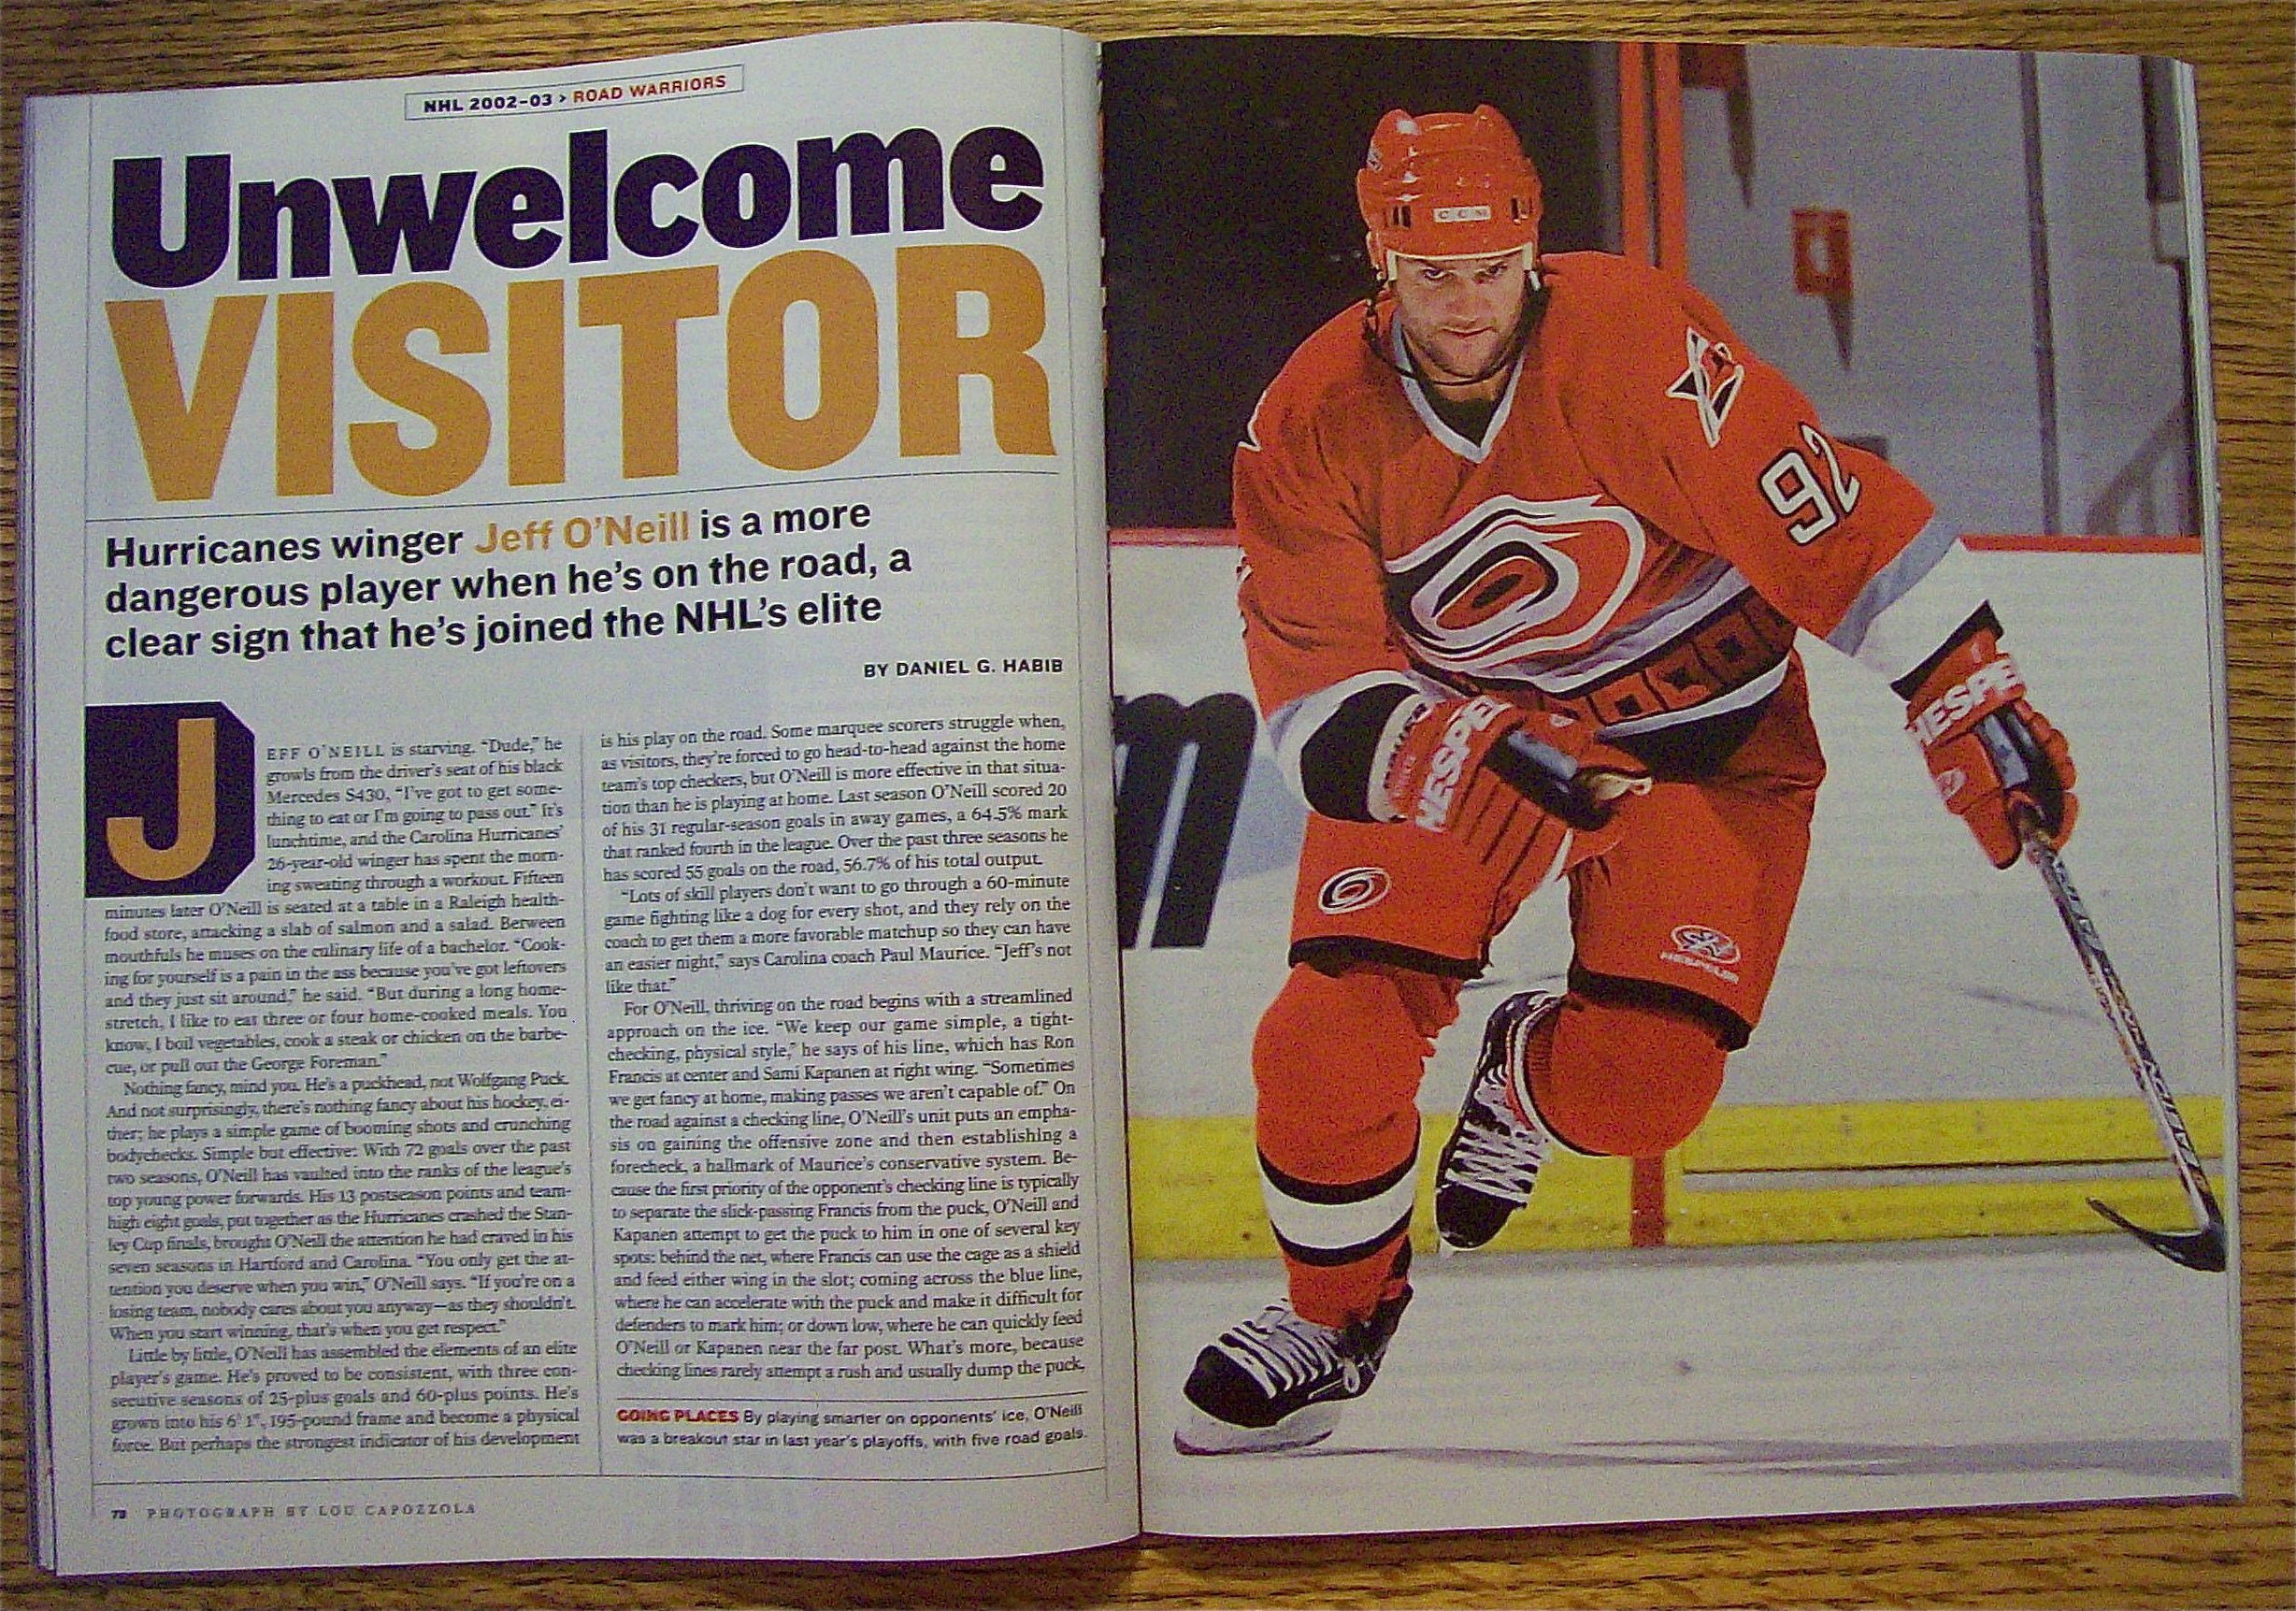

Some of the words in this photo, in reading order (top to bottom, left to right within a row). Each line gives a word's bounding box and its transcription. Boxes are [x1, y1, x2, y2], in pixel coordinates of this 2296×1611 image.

[423, 98, 464, 114] NHL
[469, 88, 552, 111] 2002-03
[572, 85, 624, 104] ROAD
[629, 74, 726, 97] WARRIORS
[111, 125, 1045, 288] Unwelcome
[105, 244, 1058, 502] VISITOR
[1758, 423, 1862, 546] 92
[106, 537, 321, 568] Hurricanes
[332, 529, 463, 564] winger
[477, 520, 552, 554] Jeff
[563, 511, 689, 549] O'Neill
[700, 509, 730, 539] is
[741, 511, 762, 538] a
[772, 504, 870, 534] more
[106, 583, 309, 617] dangerous
[320, 575, 440, 611] player
[452, 568, 556, 599] when
[567, 561, 642, 595] he's
[653, 563, 698, 589] on
[709, 553, 769, 585] the
[780, 544, 877, 580] road,
[889, 547, 911, 573] a
[106, 627, 200, 658] clear
[211, 625, 289, 660] sign
[300, 620, 377, 651] that
[389, 616, 466, 648] he's
[476, 610, 593, 649] joined
[604, 606, 664, 639] the
[675, 597, 787, 633] NHL's
[797, 592, 882, 626] elite
[863, 662, 888, 679] BY
[896, 659, 969, 677] DANIEL
[976, 658, 995, 674] G.
[1002, 657, 1063, 674] HABIB
[266, 746, 300, 761] EFF
[390, 741, 405, 757] is
[543, 735, 564, 754] he
[600, 733, 613, 749] is
[616, 731, 640, 749] his
[643, 730, 675, 751] play
[678, 731, 698, 745] on
[701, 726, 725, 744] the
[770, 723, 813, 740] Some
[816, 722, 883, 739] marquee
[887, 718, 944, 733] scorers
[948, 713, 1014, 734] struggle
[106, 716, 217, 882] J
[602, 820, 619, 839] of
[621, 820, 645, 838] his
[649, 821, 666, 838] 31
[670, 817, 782, 837] regular-season
[784, 812, 825, 834] goals
[829, 811, 846, 828] in
[850, 813, 891, 829] away
[955, 810, 969, 823] a
[970, 805, 1023, 823] 64.5%
[1026, 804, 1068, 821] mark
[665, 885, 681, 903] of
[683, 885, 716, 902] skill
[718, 885, 773, 904] players
[818, 883, 856, 897] want
[860, 882, 877, 896] to
[880, 882, 900, 899] go
[903, 875, 969, 896] through
[971, 879, 983, 891] a
[985, 872, 1069, 890] 60-minute
[168, 1013, 176, 1029] I
[179, 1013, 209, 1029] like
[213, 1015, 230, 1028] to
[233, 1014, 258, 1028] eat
[262, 1011, 304, 1028] three
[308, 1013, 325, 1026] or
[330, 1009, 365, 1026] four
[367, 1006, 478, 1024] home-cooked
[538, 1003, 568, 1020] You
[610, 1136, 631, 1153] sis
[636, 1139, 657, 1152] on
[662, 1134, 722, 1156] gaining
[727, 1134, 753, 1151] the
[757, 1133, 828, 1150] offensive
[835, 1136, 873, 1149] zone
[879, 1130, 911, 1149] and
[917, 1130, 954, 1148] then
[961, 1127, 1063, 1146] establishing
[1068, 1129, 1078, 1142] a
[108, 1261, 151, 1275] seven
[155, 1260, 214, 1274] seasons
[218, 1257, 235, 1273] in
[237, 1255, 305, 1273] Hartford
[309, 1254, 338, 1272] and
[458, 1251, 492, 1272] only
[495, 1254, 521, 1272] get
[524, 1250, 549, 1267] the
[674, 1343, 691, 1356] or
[696, 1340, 764, 1359] Kapanen
[768, 1344, 802, 1357] near
[807, 1340, 832, 1358] the
[836, 1339, 859, 1357] far
[1021, 1336, 1084, 1353] because
[265, 1367, 320, 1387] proved
[323, 1369, 340, 1383] to
[343, 1366, 363, 1383] be
[457, 1363, 494, 1380] with
[497, 1363, 538, 1379] three
[615, 1407, 671, 1425] GOING
[673, 1408, 739, 1427] PLACES
[742, 1408, 762, 1427] By
[766, 1410, 819, 1428] playing
[824, 1413, 880, 1426] smarter
[885, 1413, 905, 1426] on
[616, 1433, 647, 1450] was
[650, 1433, 660, 1446] a
[663, 1431, 729, 1446] breakout
[732, 1433, 761, 1447] star
[764, 1435, 780, 1447] in
[782, 1433, 810, 1447] last
[932, 1433, 967, 1449] with
[970, 1431, 1000, 1447] five
[1004, 1430, 1040, 1446] road
